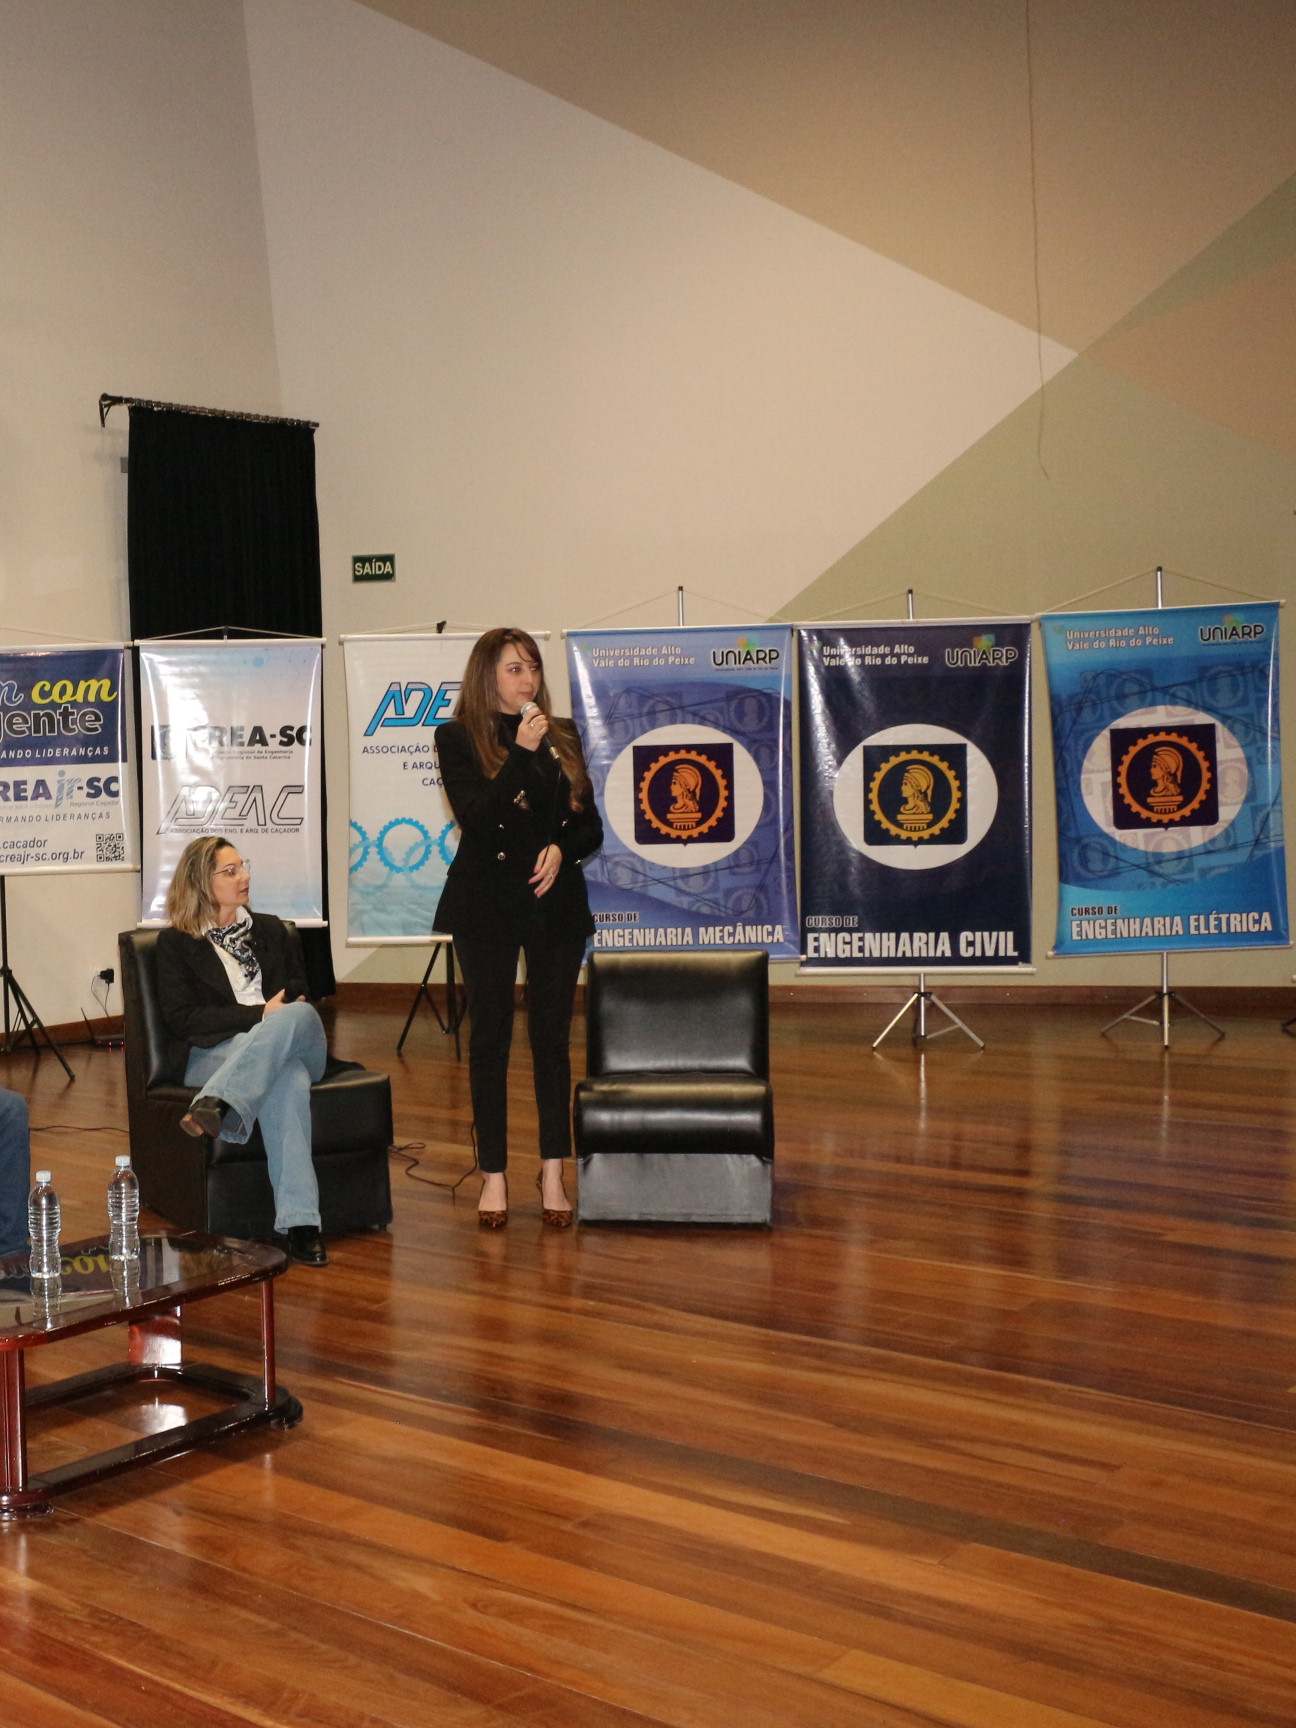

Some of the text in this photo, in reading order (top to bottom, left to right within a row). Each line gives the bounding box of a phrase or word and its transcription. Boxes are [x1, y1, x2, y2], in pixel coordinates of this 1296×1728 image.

[355, 558, 393, 576] SAÍDA
[1066, 625, 1159, 639] Universidade Alto
[1199, 623, 1265, 643] UNIARP
[894, 644, 915, 654] Alto
[1067, 636, 1174, 650] Vale do Rio do Peixe
[592, 645, 681, 657] Universidade Alto
[711, 648, 780, 667] UNIARP
[946, 647, 1019, 667] UNIARP
[592, 656, 695, 668] Vale do Rio do Peixe
[823, 657, 845, 666] Vale
[865, 656, 882, 665] Rio
[885, 655, 898, 665] do
[901, 654, 929, 664] Peixe
[31, 678, 118, 704] com
[363, 681, 463, 736] ADE
[35, 746, 109, 758] LIDERANÇAS
[362, 742, 430, 756] ASSOCIAÇÃO
[402, 761, 440, 770] E ARQU
[421, 778, 445, 788] CAÇ
[45, 811, 111, 823] LIDERANÇAS
[593, 912, 639, 923] CURSO DE
[1070, 905, 1119, 917] CURSO DE
[806, 915, 859, 928] CURSO DE
[1071, 910, 1273, 941] ENGENHARIA ELÉTRICA
[594, 922, 784, 948] ENGENHARIA MECÂNICA
[806, 931, 1019, 958] ENGENHARIA CIVIL
